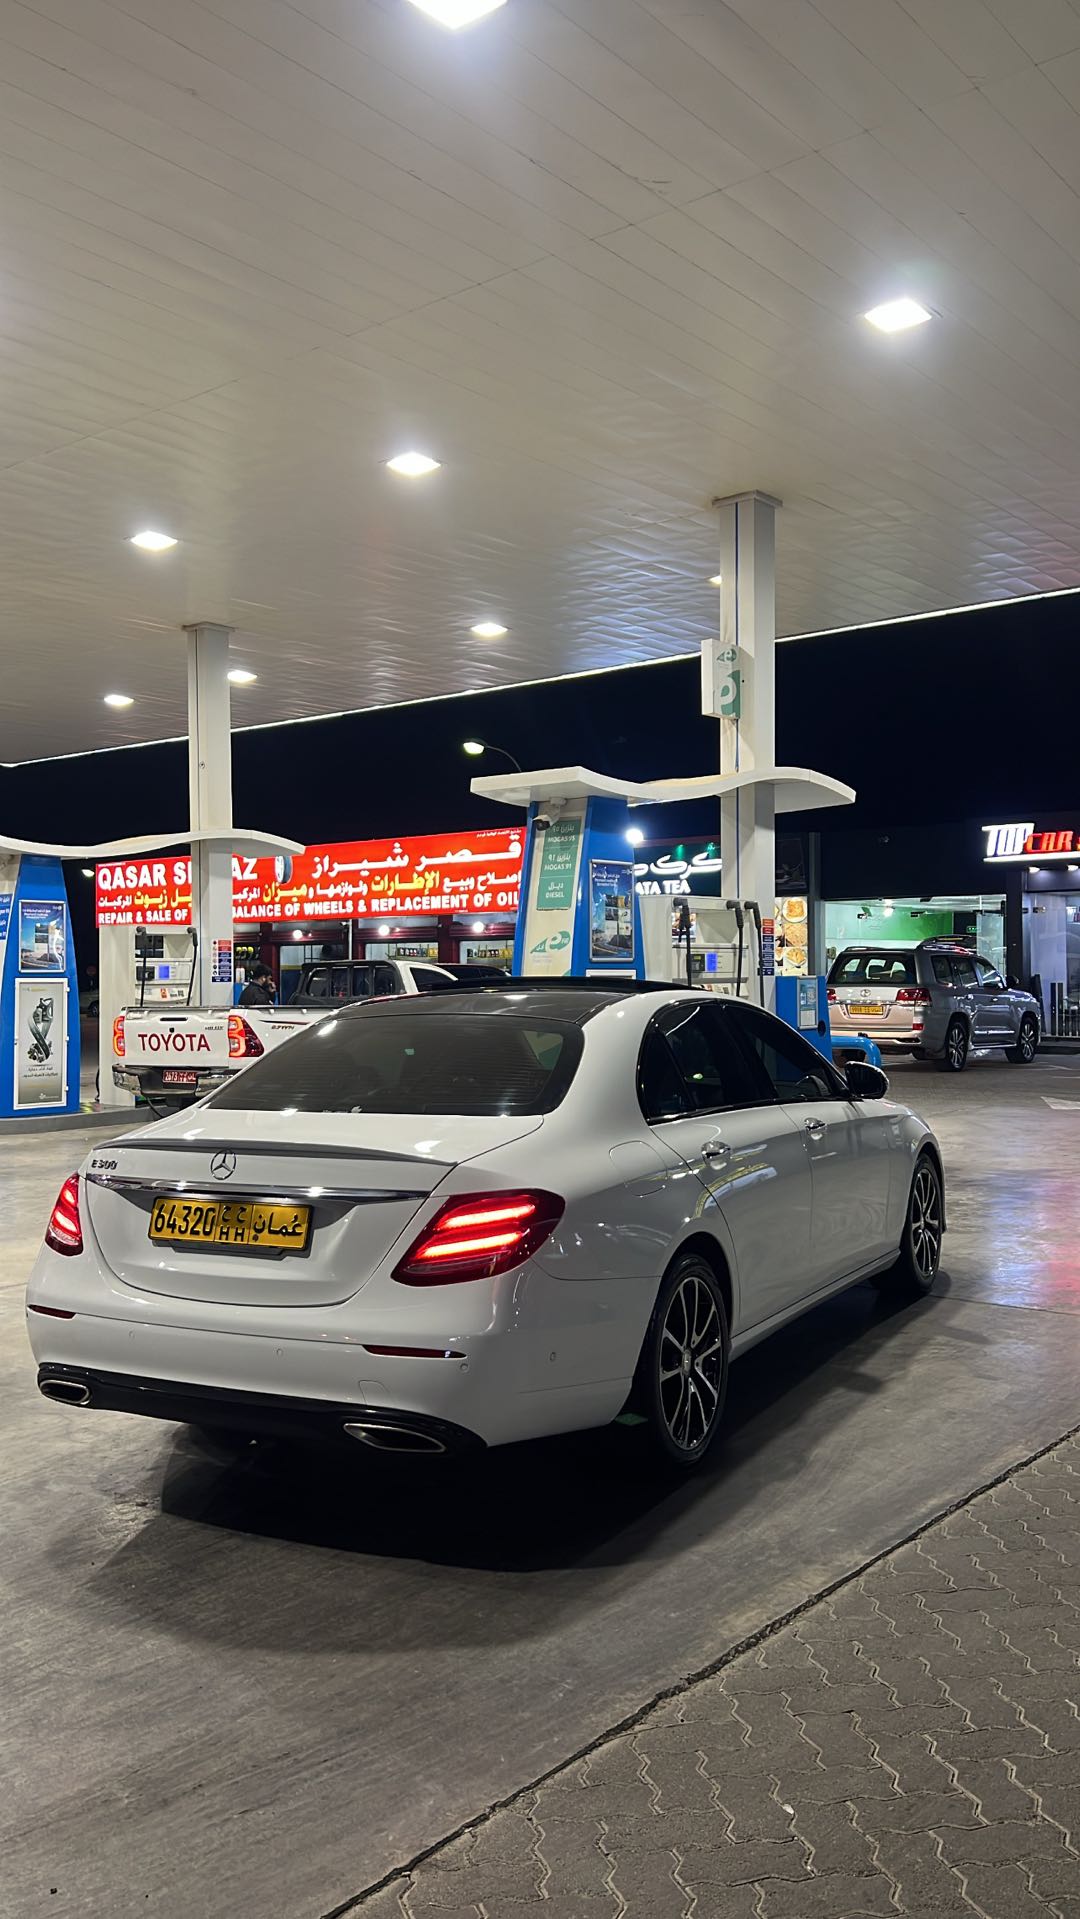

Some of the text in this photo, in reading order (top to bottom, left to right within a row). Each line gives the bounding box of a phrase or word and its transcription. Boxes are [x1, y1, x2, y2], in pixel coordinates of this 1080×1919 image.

[312, 834, 522, 878] قصر شيراز
[1025, 831, 1073, 854] CAR
[98, 863, 166, 891] QASAR
[663, 880, 691, 894] TEA
[98, 911, 133, 924] REPAIR
[136, 910, 143, 922] &
[146, 909, 171, 922] SALE
[176, 908, 188, 920] OF
[285, 903, 300, 916] OF
[304, 900, 353, 915] WHEELS
[358, 899, 367, 912] &
[371, 893, 469, 912] REPLACEMENT
[473, 892, 492, 907] OF
[138, 1033, 211, 1051] TOYOTA
[154, 1203, 217, 1236] 64320
